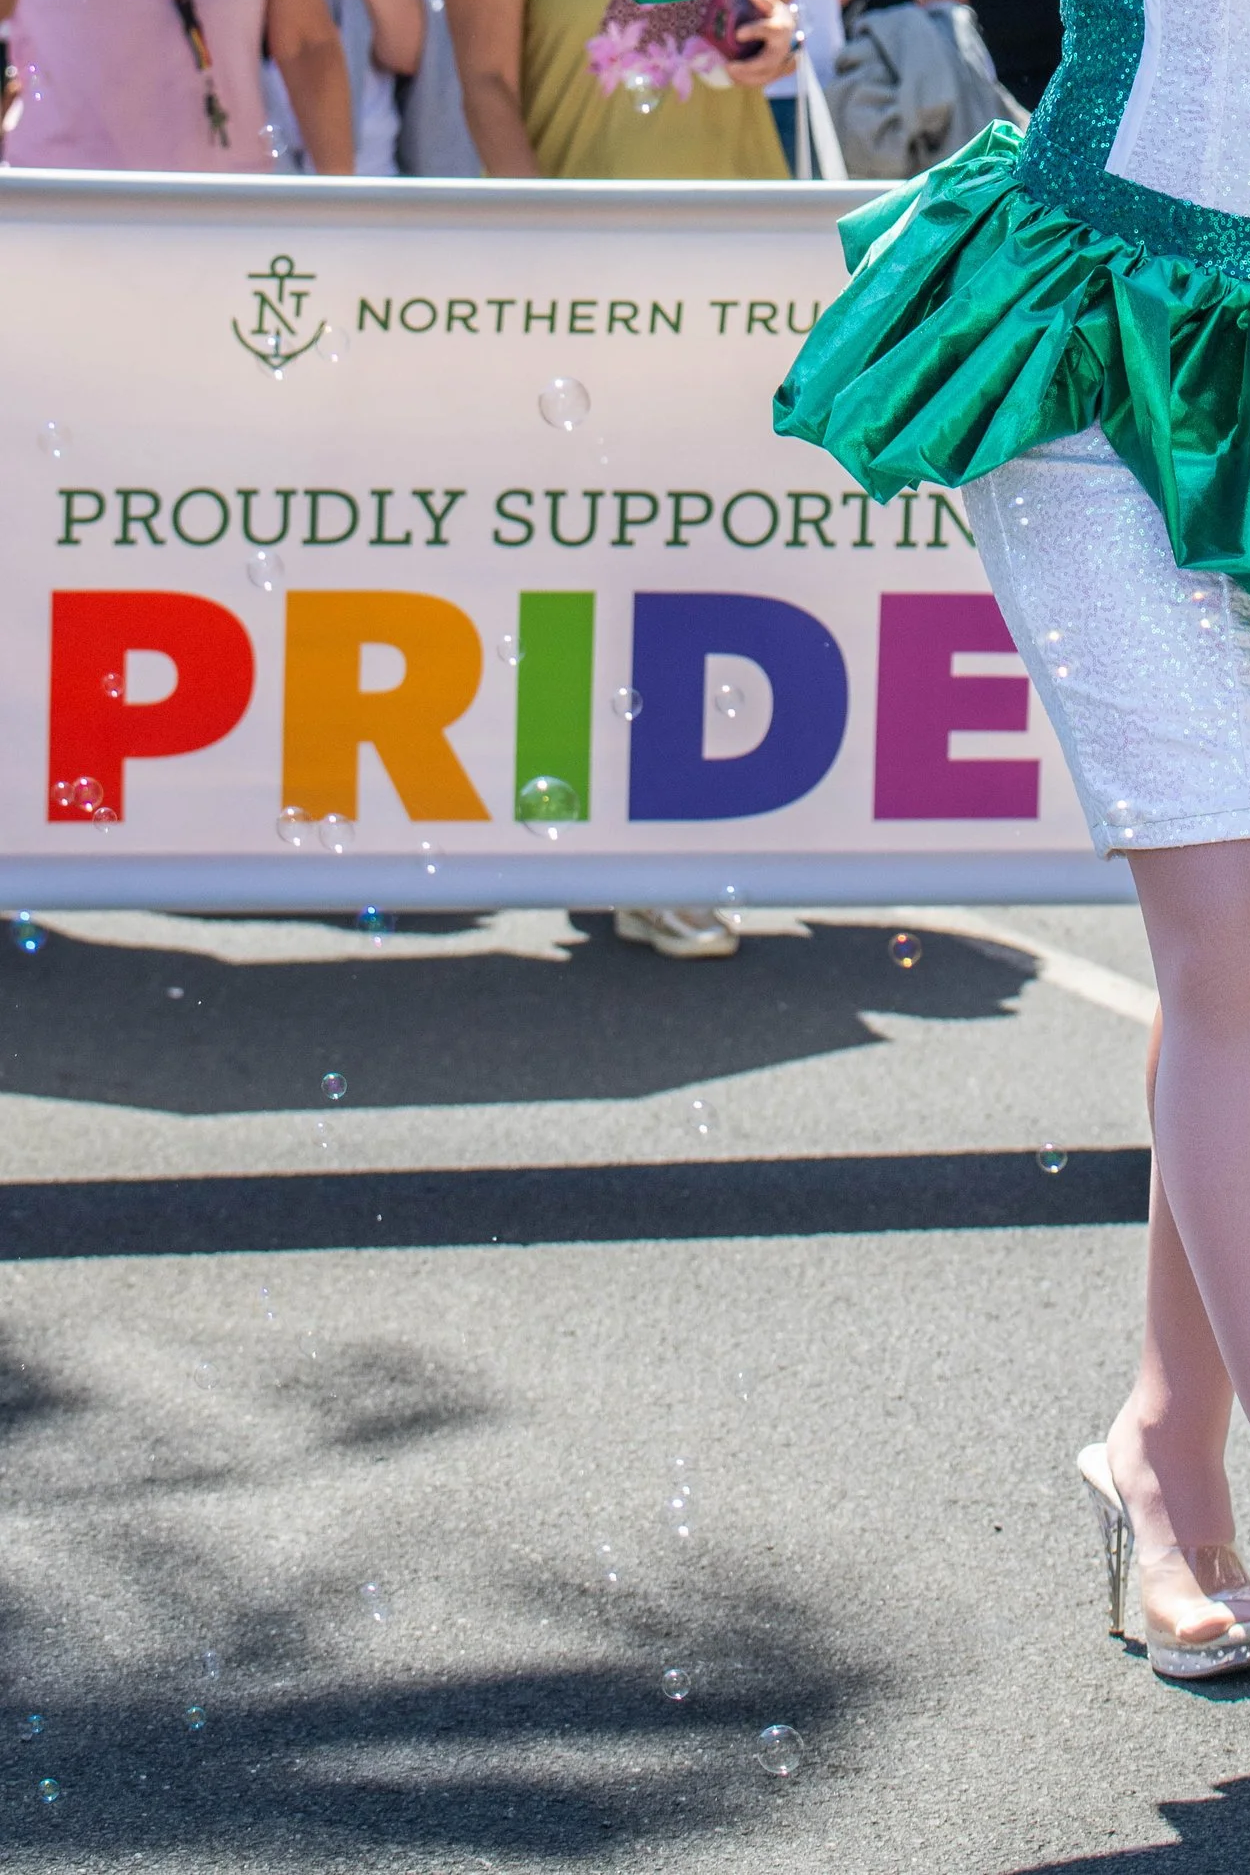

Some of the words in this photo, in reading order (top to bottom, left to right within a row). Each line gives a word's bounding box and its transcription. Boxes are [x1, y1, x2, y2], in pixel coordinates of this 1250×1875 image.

[357, 296, 684, 335] NORTHERN
[709, 299, 821, 336] TRU
[56, 487, 468, 547] PROUDLY
[46, 589, 1041, 824] PRIDE
